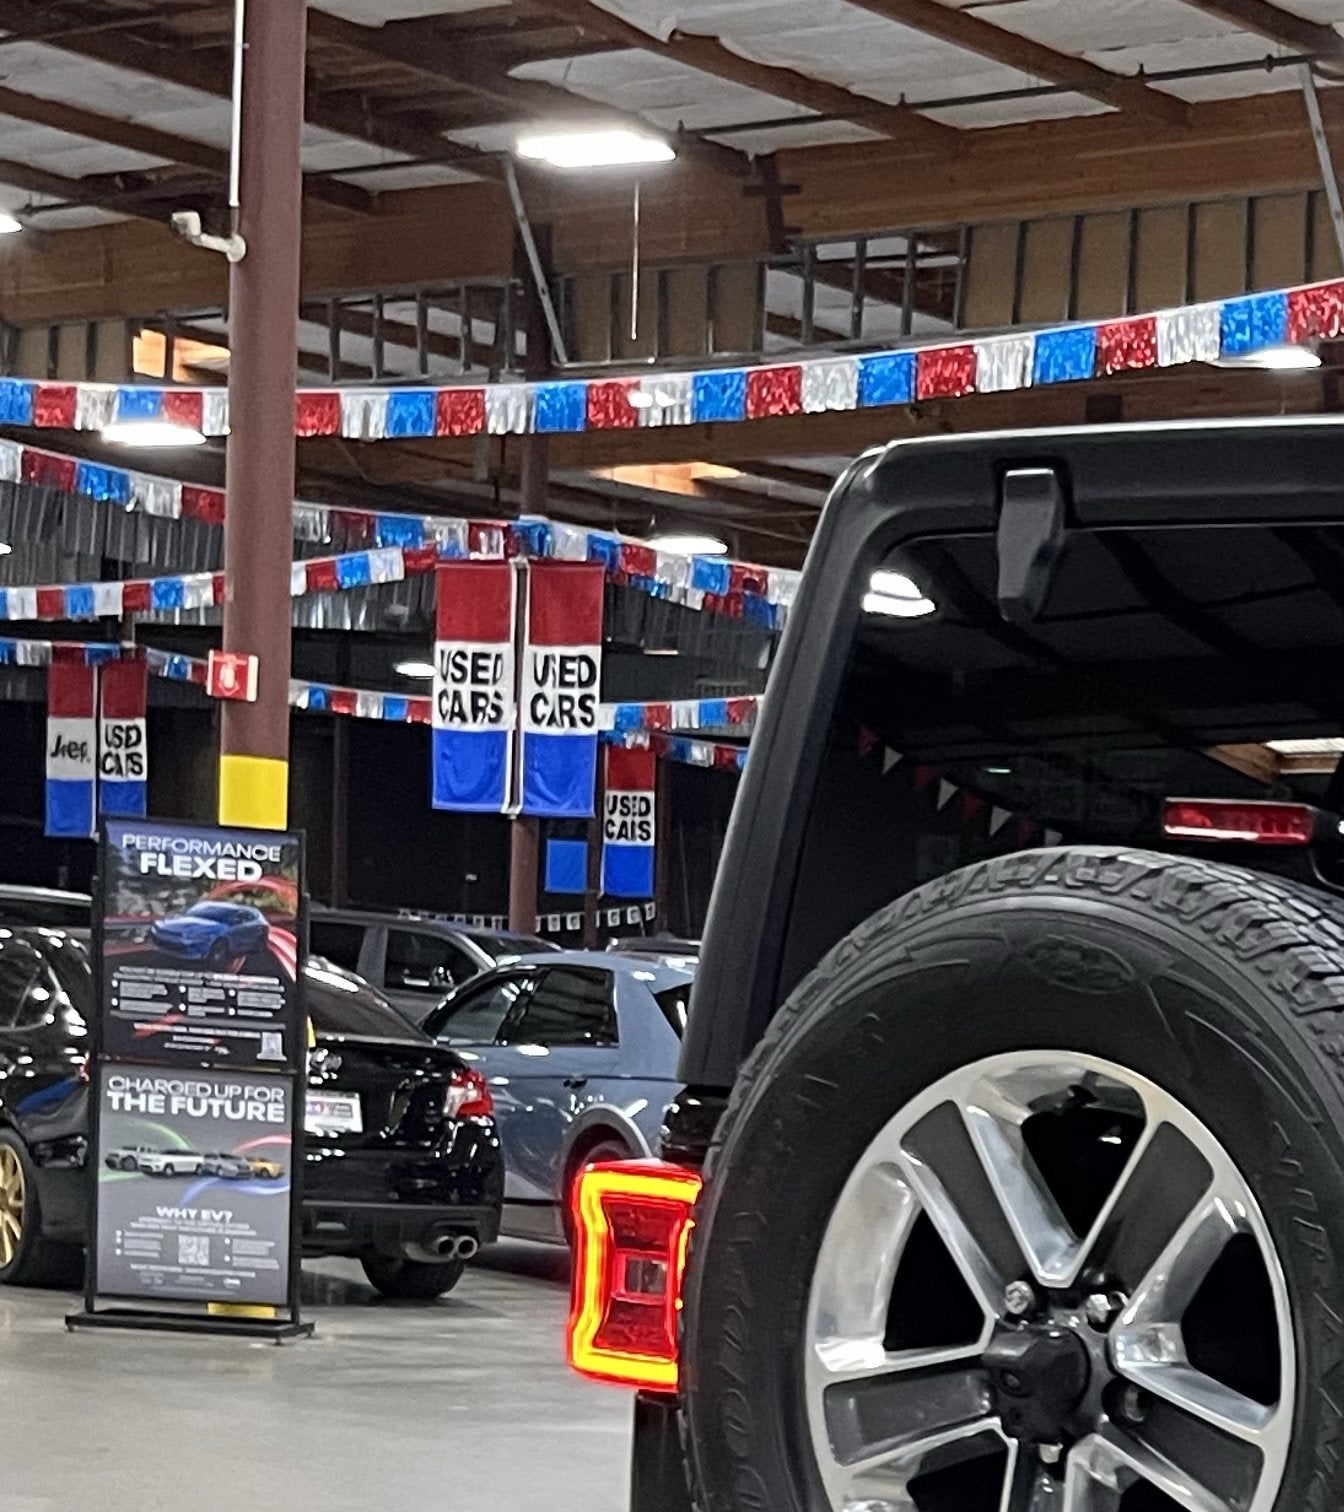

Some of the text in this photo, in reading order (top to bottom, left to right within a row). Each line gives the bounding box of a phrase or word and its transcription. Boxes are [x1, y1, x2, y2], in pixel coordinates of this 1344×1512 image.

[122, 833, 281, 862] PERFORMANCE
[140, 853, 263, 882] FLEXED
[108, 1075, 284, 1102] CHARGED UP FOR
[106, 1090, 165, 1114] THE
[170, 1096, 285, 1123] FUTURE
[156, 1206, 233, 1225] WHY EV?
